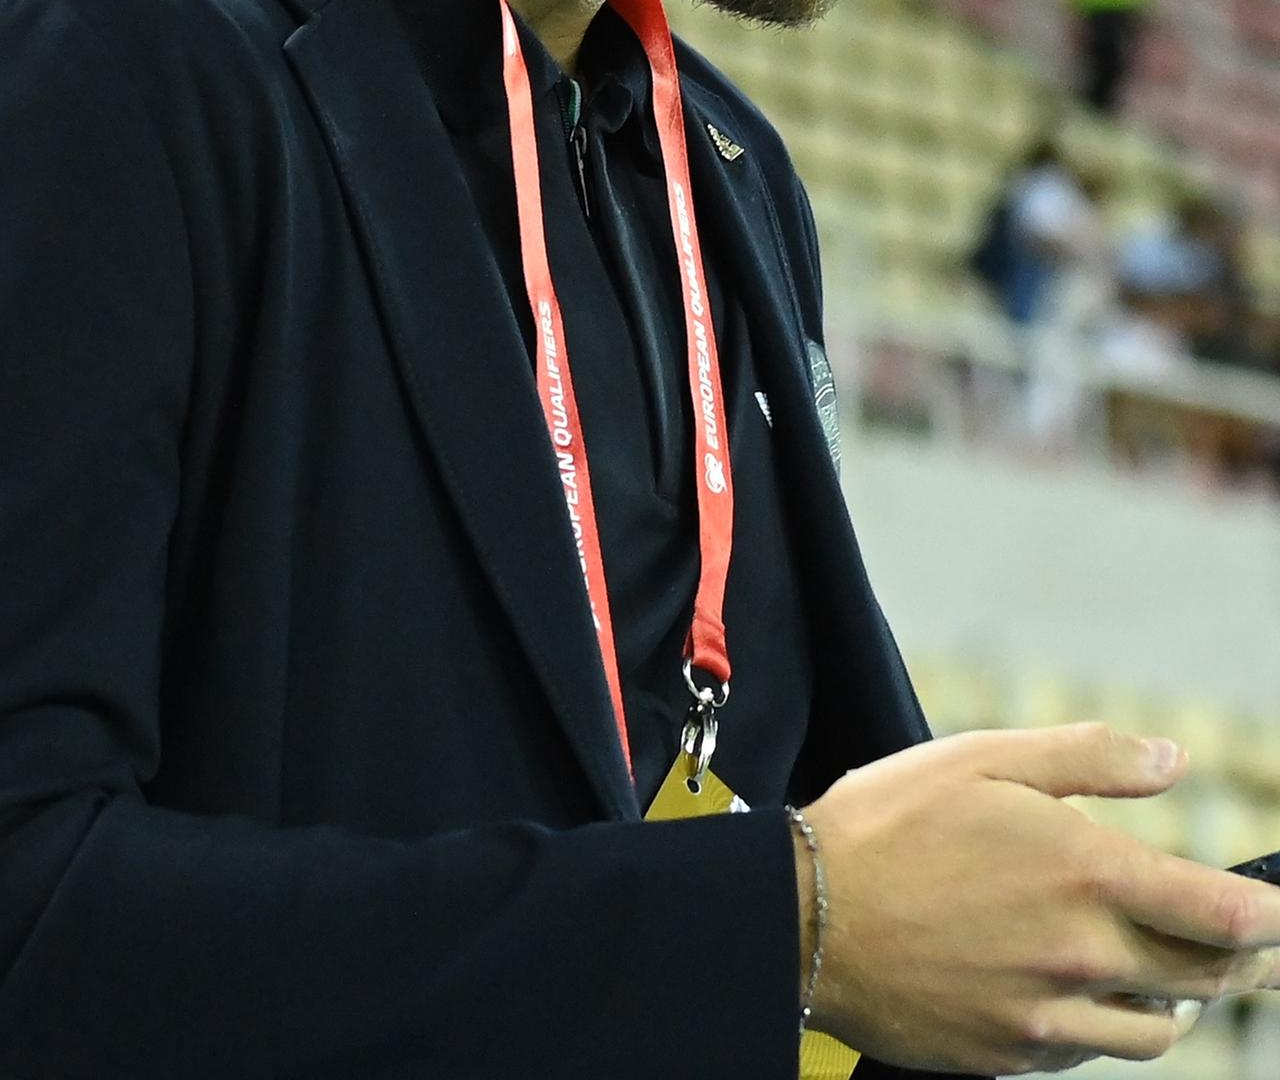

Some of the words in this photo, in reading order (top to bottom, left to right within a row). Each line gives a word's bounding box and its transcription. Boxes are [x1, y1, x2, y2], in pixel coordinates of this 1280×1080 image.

[673, 181, 705, 318] QUALIFIERS
[538, 299, 573, 447] QUALIFIERS
[694, 319, 719, 451] EUROPEAN
